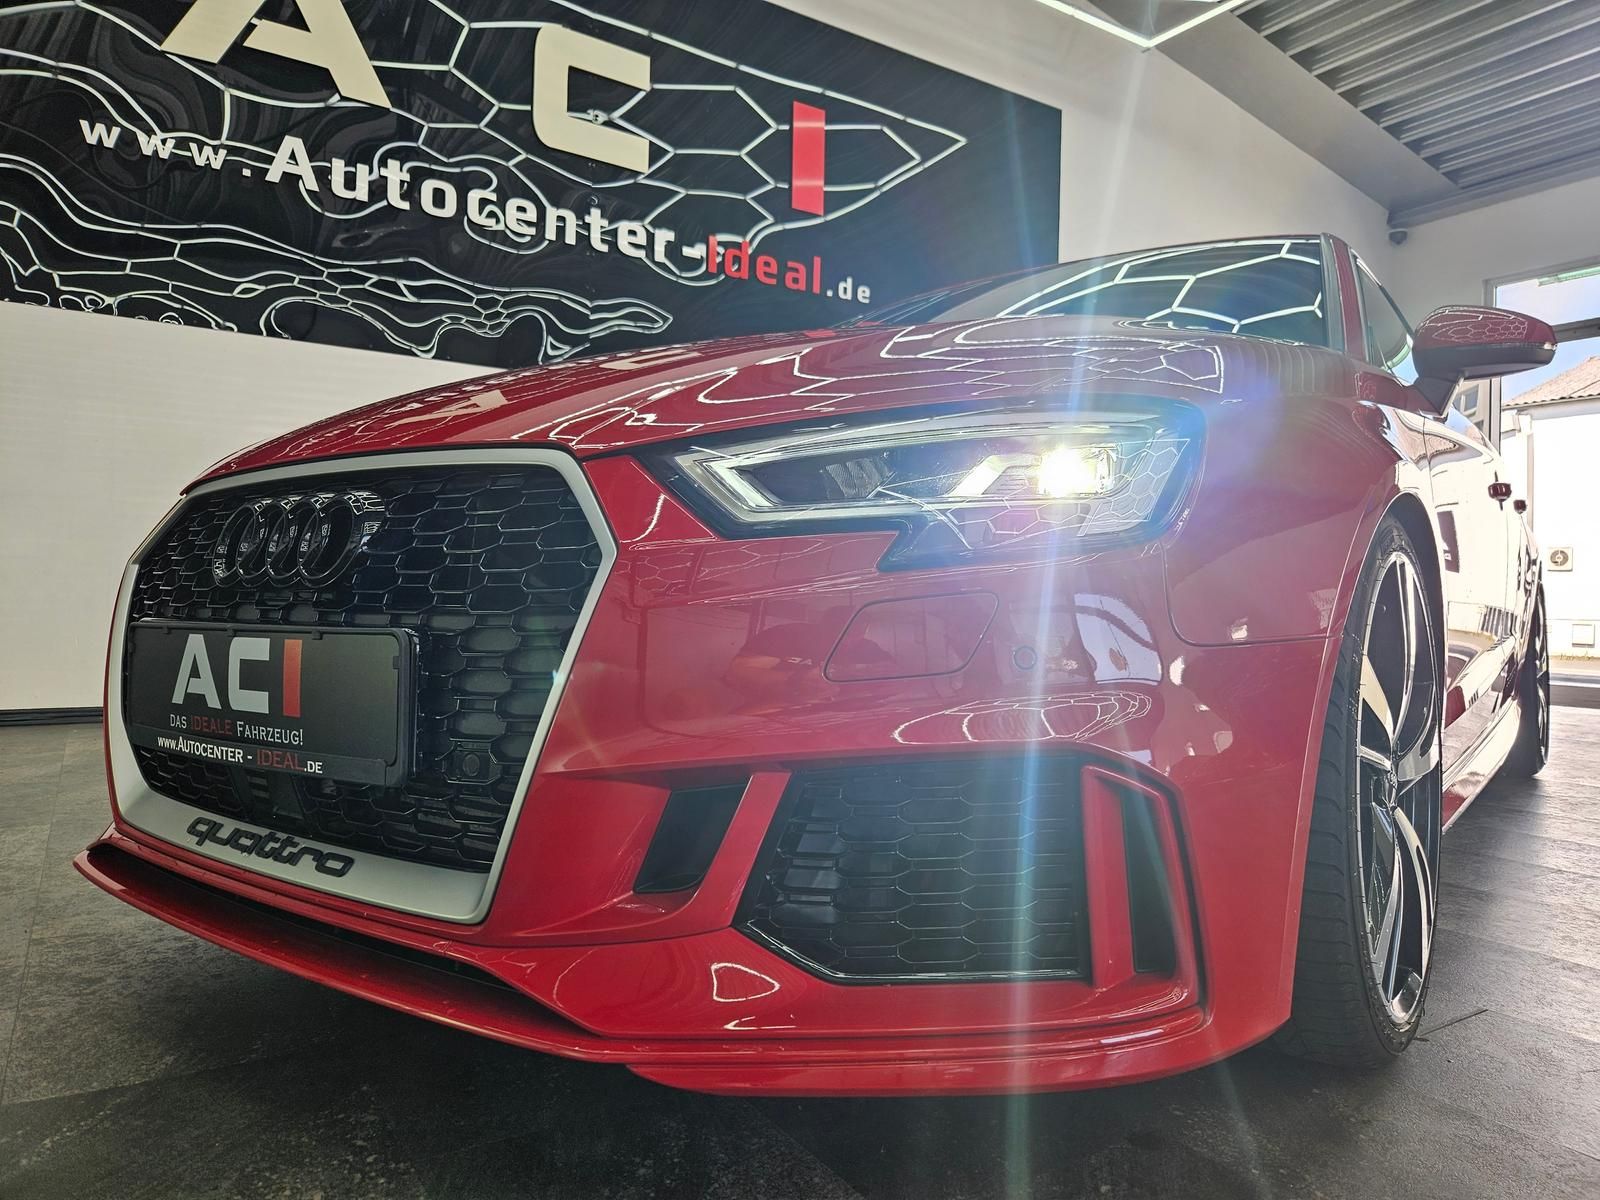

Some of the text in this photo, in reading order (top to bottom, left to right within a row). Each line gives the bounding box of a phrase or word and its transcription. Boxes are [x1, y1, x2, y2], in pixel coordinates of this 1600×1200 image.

[171, 633, 303, 718] ACI
[169, 713, 187, 730] DAS
[191, 714, 233, 736] IDEALE
[186, 816, 355, 878] quattro
